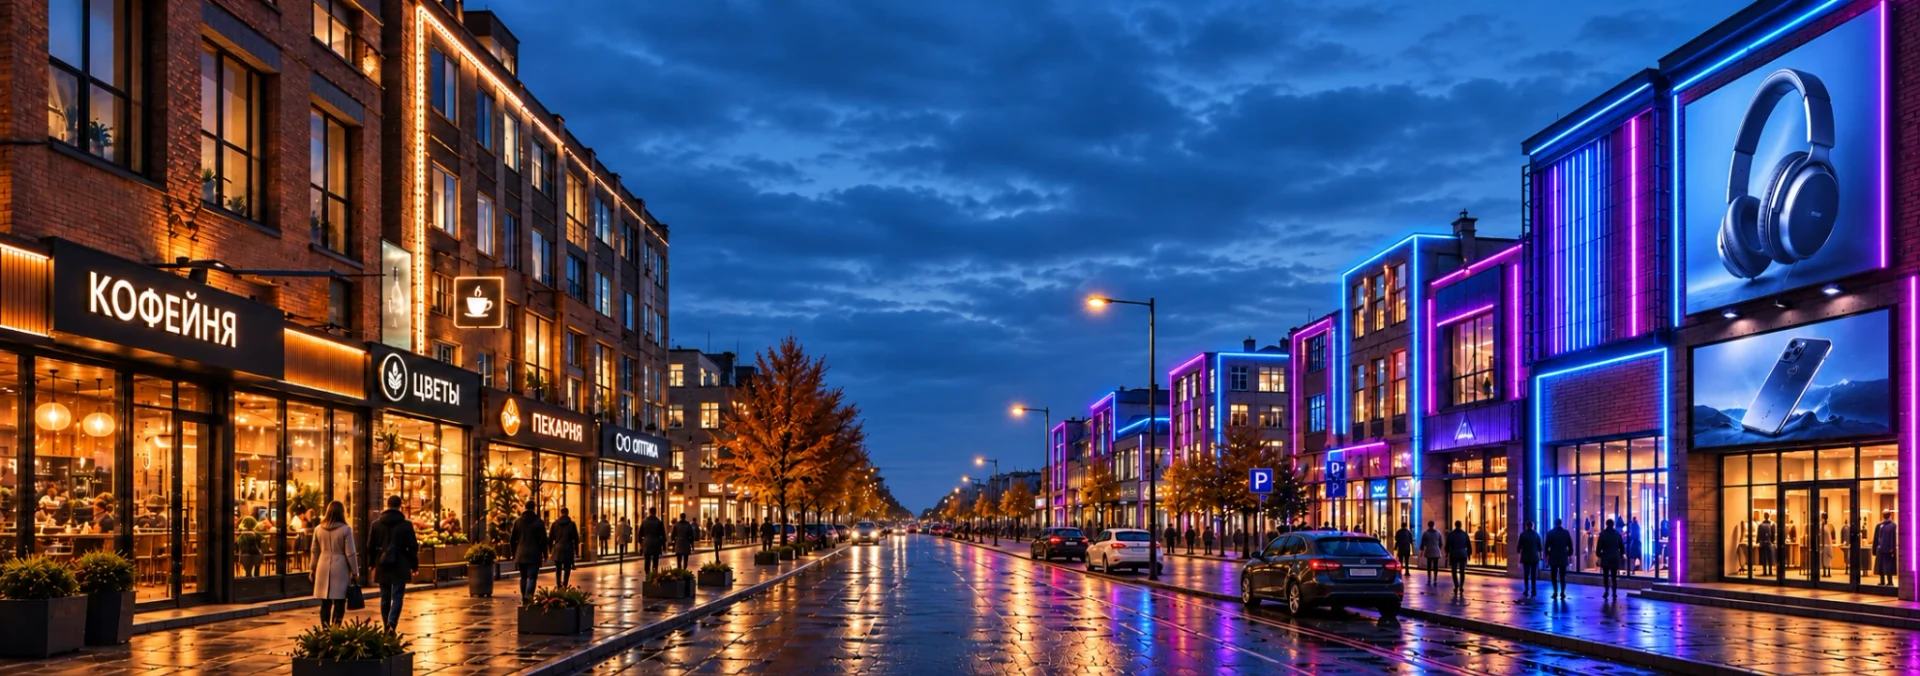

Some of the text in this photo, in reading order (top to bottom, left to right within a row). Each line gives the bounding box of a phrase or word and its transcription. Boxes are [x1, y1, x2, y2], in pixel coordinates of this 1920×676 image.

[89, 271, 237, 348] КОФЕЙНЯ
[413, 372, 460, 406] ЦВЕТЫ
[532, 412, 583, 442] ПЕКАРНЯ
[632, 438, 659, 459] ОПТИКА
[1255, 471, 1268, 490] P
